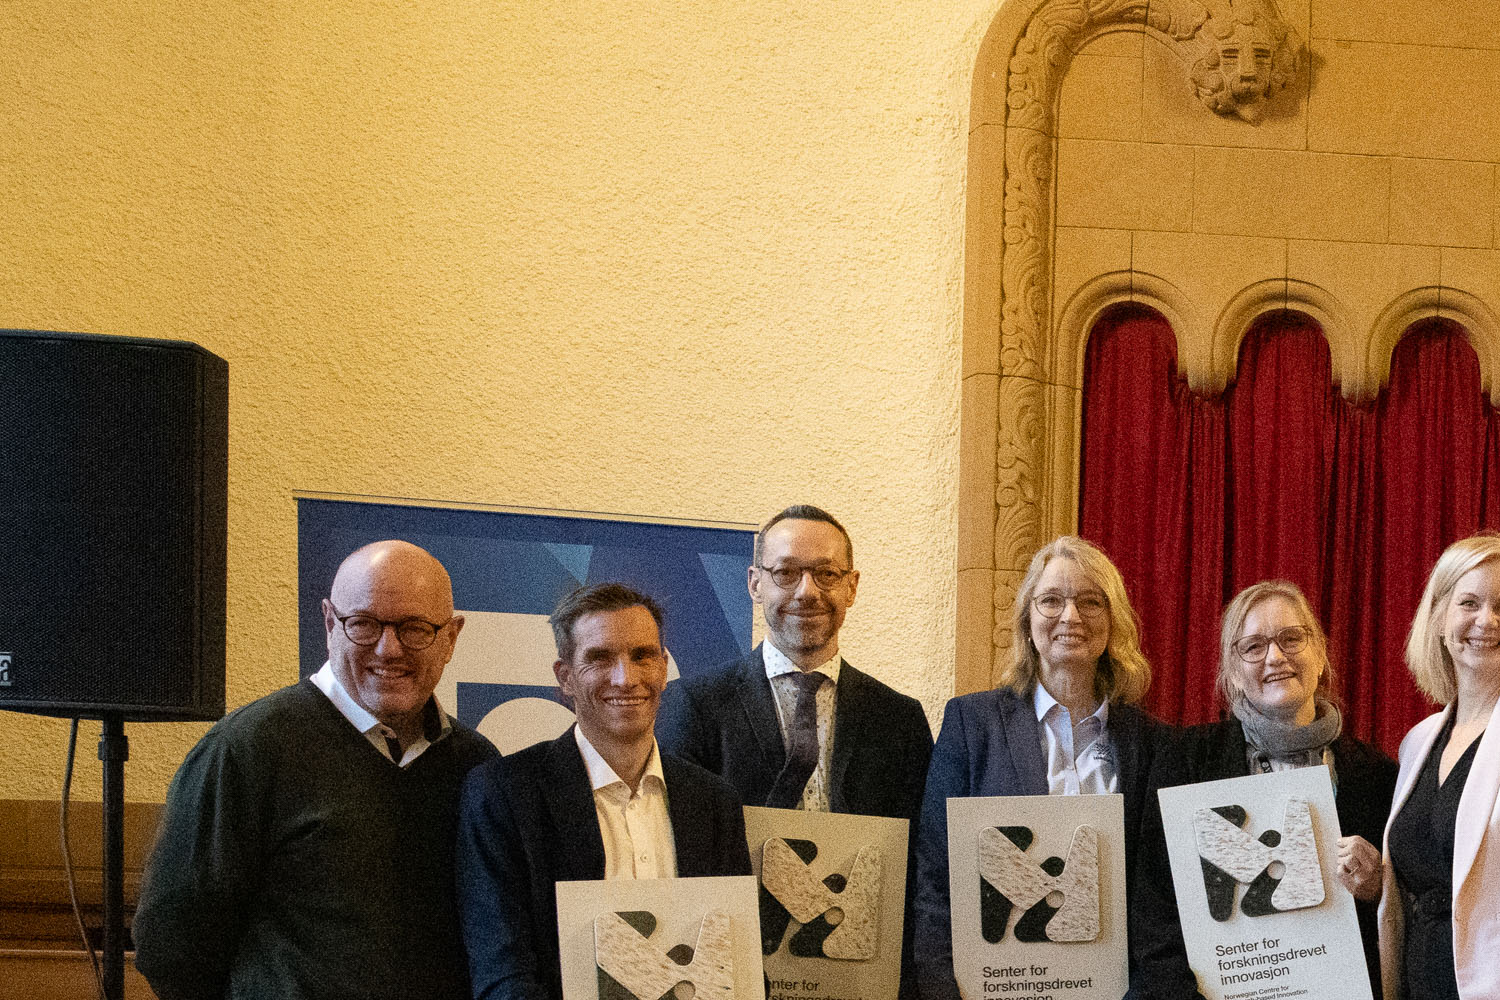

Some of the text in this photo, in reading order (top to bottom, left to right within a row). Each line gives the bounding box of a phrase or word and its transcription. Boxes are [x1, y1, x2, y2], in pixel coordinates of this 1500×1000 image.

[1216, 938, 1280, 957] Senter for
[1218, 944, 1327, 971] forskningsdrevet
[983, 965, 1048, 978] Senter for
[1220, 966, 1290, 985] innovasjon
[770, 979, 820, 991] nter for
[983, 977, 1093, 992] forskningsdrevet
[1224, 989, 1258, 1000] Norwegian
[1259, 987, 1280, 995] Centre
[1277, 989, 1308, 999] Innovation
